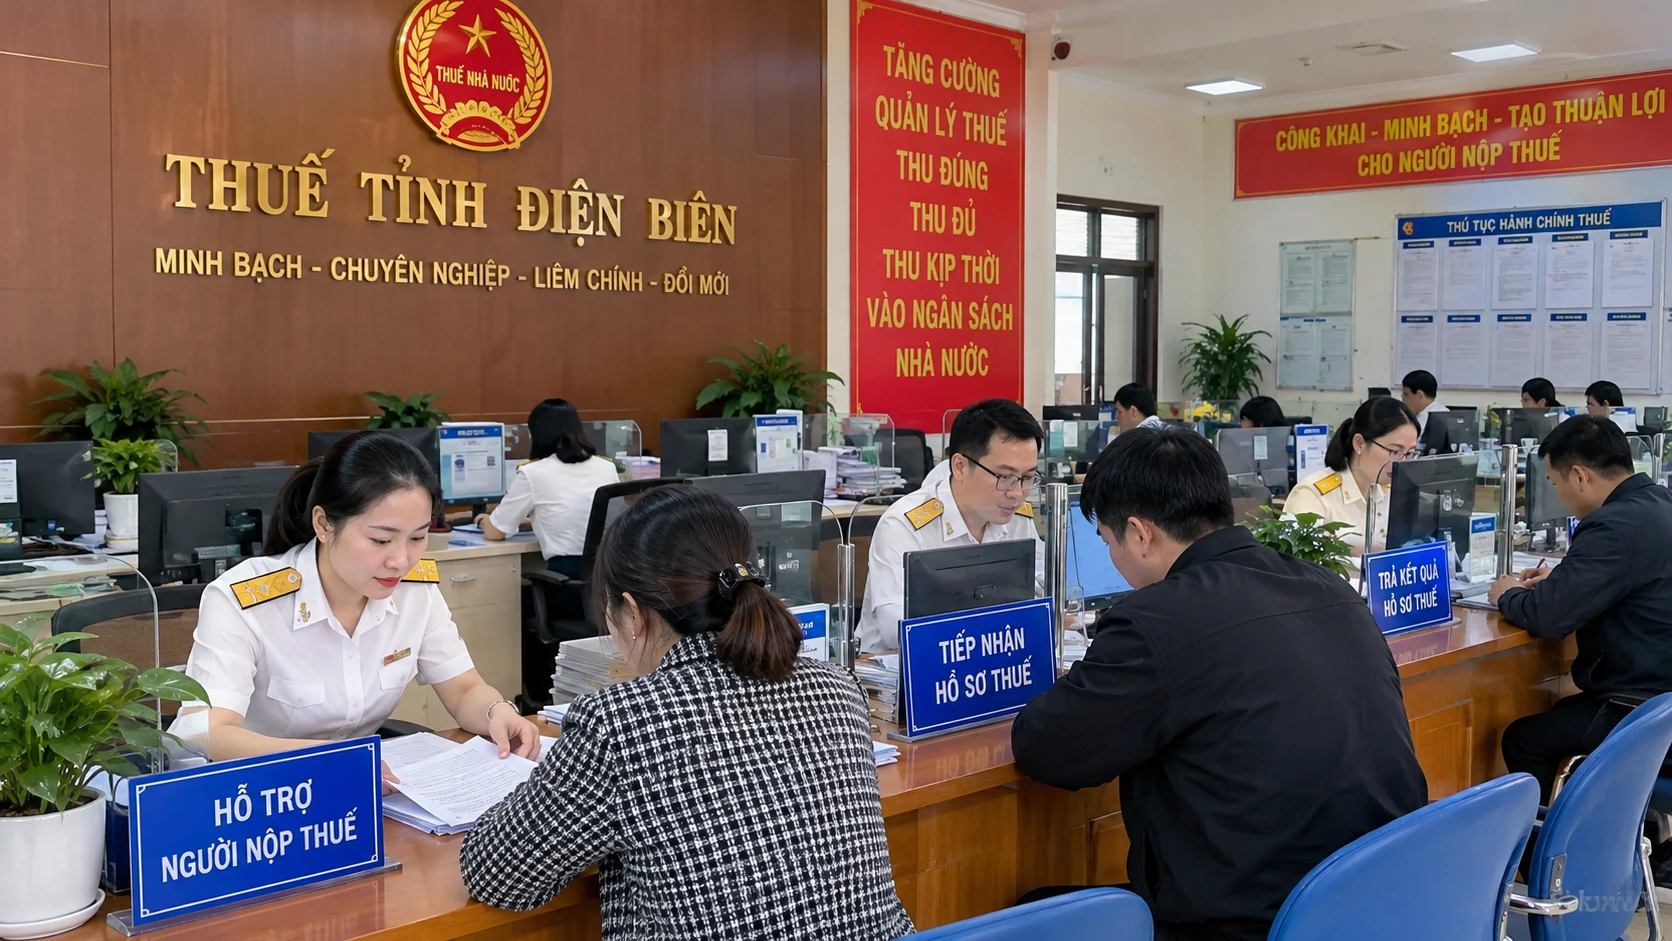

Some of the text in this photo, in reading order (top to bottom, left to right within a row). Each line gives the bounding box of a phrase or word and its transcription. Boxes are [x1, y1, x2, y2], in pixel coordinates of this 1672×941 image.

[883, 41, 1000, 98] TĂNG CƯỜNG
[875, 90, 1008, 146] QUẢN LÝ THUẾ
[1276, 125, 1321, 152] CÔNG
[1326, 122, 1366, 147] KHAI
[1384, 115, 1431, 141] MINH
[1437, 108, 1488, 138] BẠCH
[1508, 102, 1547, 132] TẠO
[1553, 90, 1623, 125] THUẬN
[1631, 87, 1666, 119] LỢI
[896, 149, 988, 191] THU ĐÚNG
[1357, 129, 1563, 177] CHO NGƯỜI NỘP THUẾ
[166, 149, 737, 247] THUẾ TỈNH ĐIỆN BIÊN
[910, 198, 976, 236] THU ĐỦ
[1536, 210, 1574, 229] CHÍNH
[155, 248, 223, 276] MINH
[234, 251, 302, 283] BẠCH
[330, 254, 423, 284] CHUYÊN
[433, 259, 510, 291] NGHIỆP
[534, 262, 579, 290] LIÊM
[587, 265, 643, 292] CHÍNH
[663, 265, 692, 294] ĐỔI
[700, 270, 729, 295] MỚI
[882, 248, 1000, 288] THU KỊP THỜI
[867, 291, 1013, 331] VÀO NGÂN SÁCH
[896, 341, 935, 378] NHÀ
[1378, 564, 1398, 590] TRẢ
[1399, 593, 1413, 614] SƠ
[1414, 584, 1438, 611] THUẾ
[939, 624, 1025, 664] TIẾP NHẬN
[935, 654, 1033, 705] HỒ SƠ THUẾ
[214, 778, 313, 827] HỖ TRỢ
[161, 807, 358, 883] NGƯỜI NỘP THUẾ
